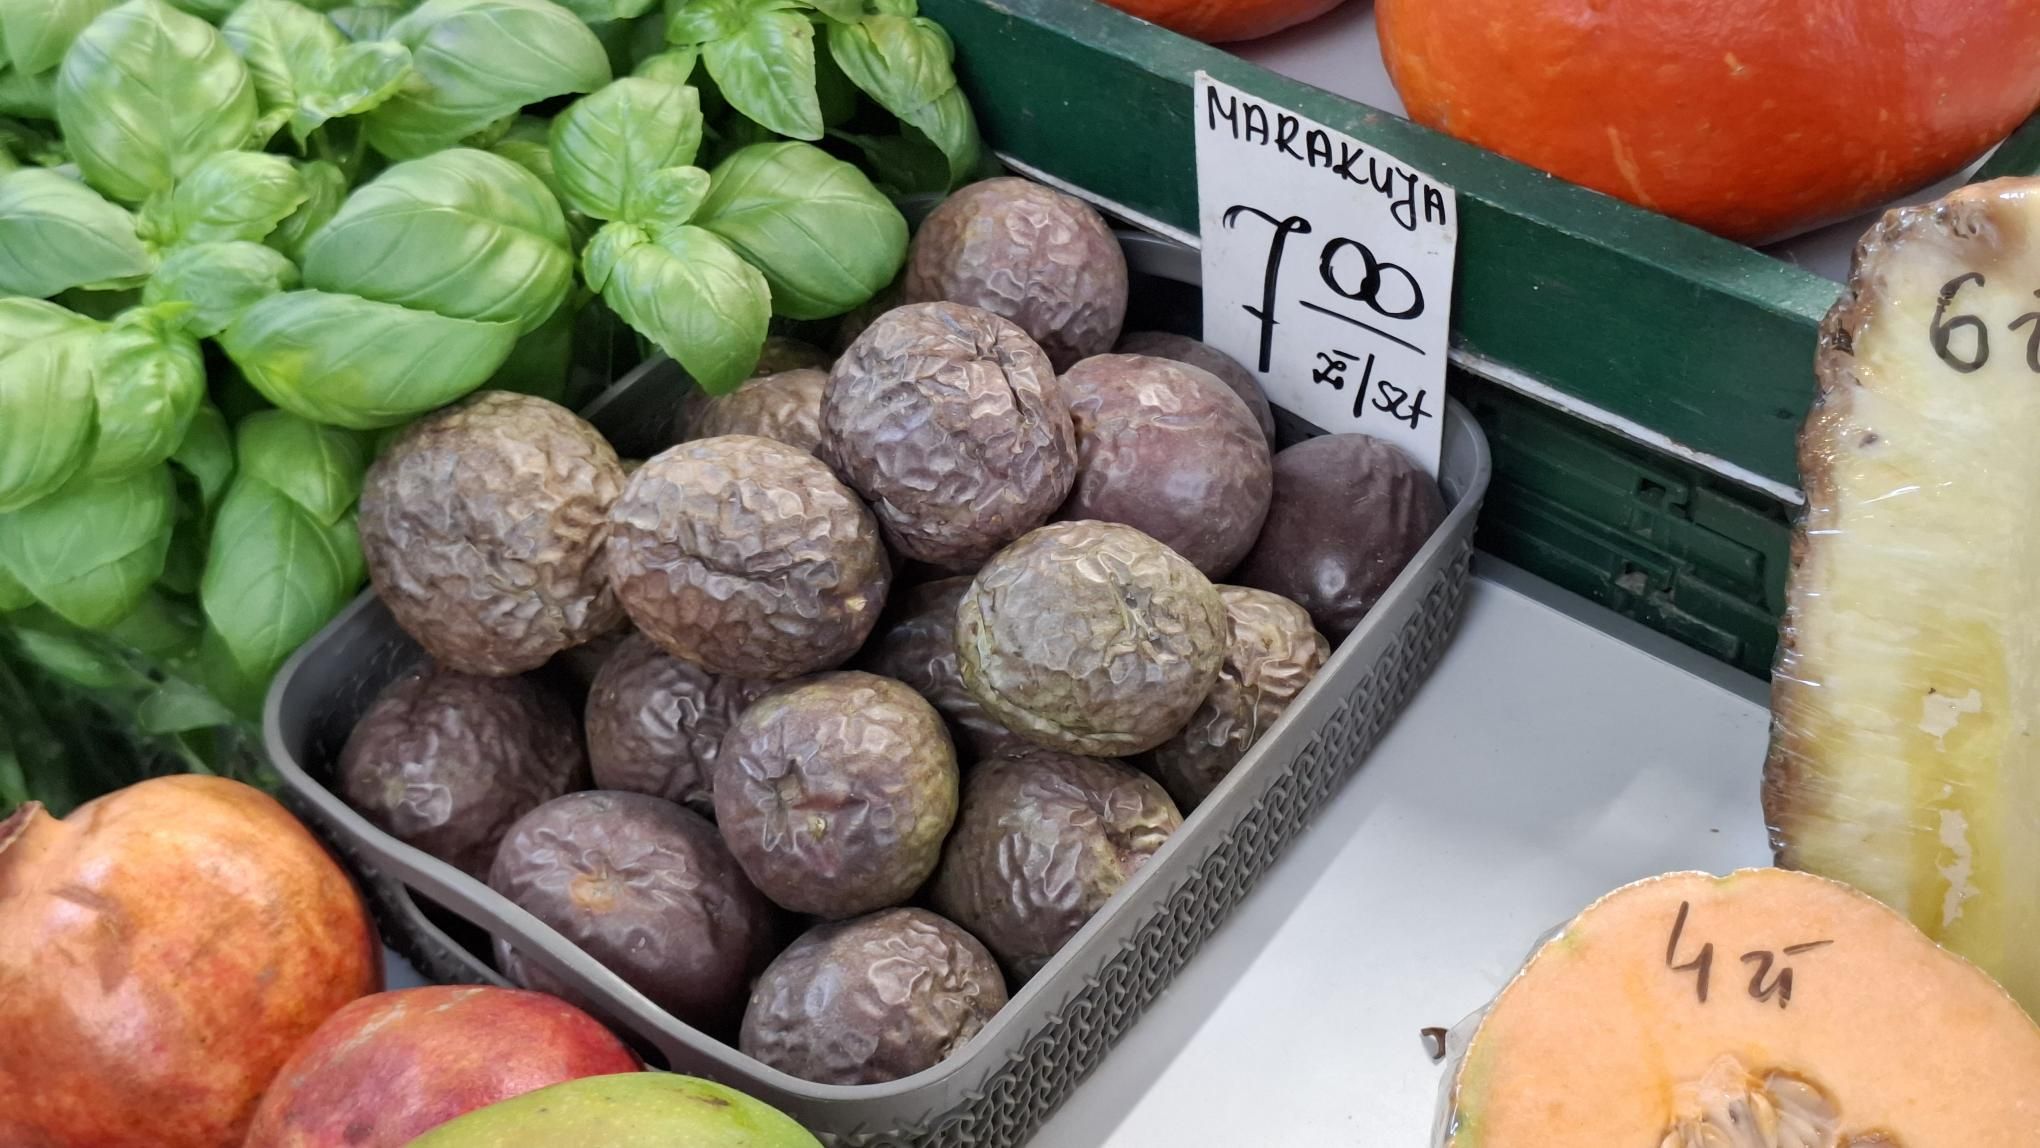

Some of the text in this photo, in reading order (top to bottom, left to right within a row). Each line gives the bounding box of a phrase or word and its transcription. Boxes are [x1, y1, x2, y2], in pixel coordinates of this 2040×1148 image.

[1207, 85, 1447, 231] MARAKUJA
[1929, 271, 1990, 374] 6
[1665, 900, 1714, 1004] 4
